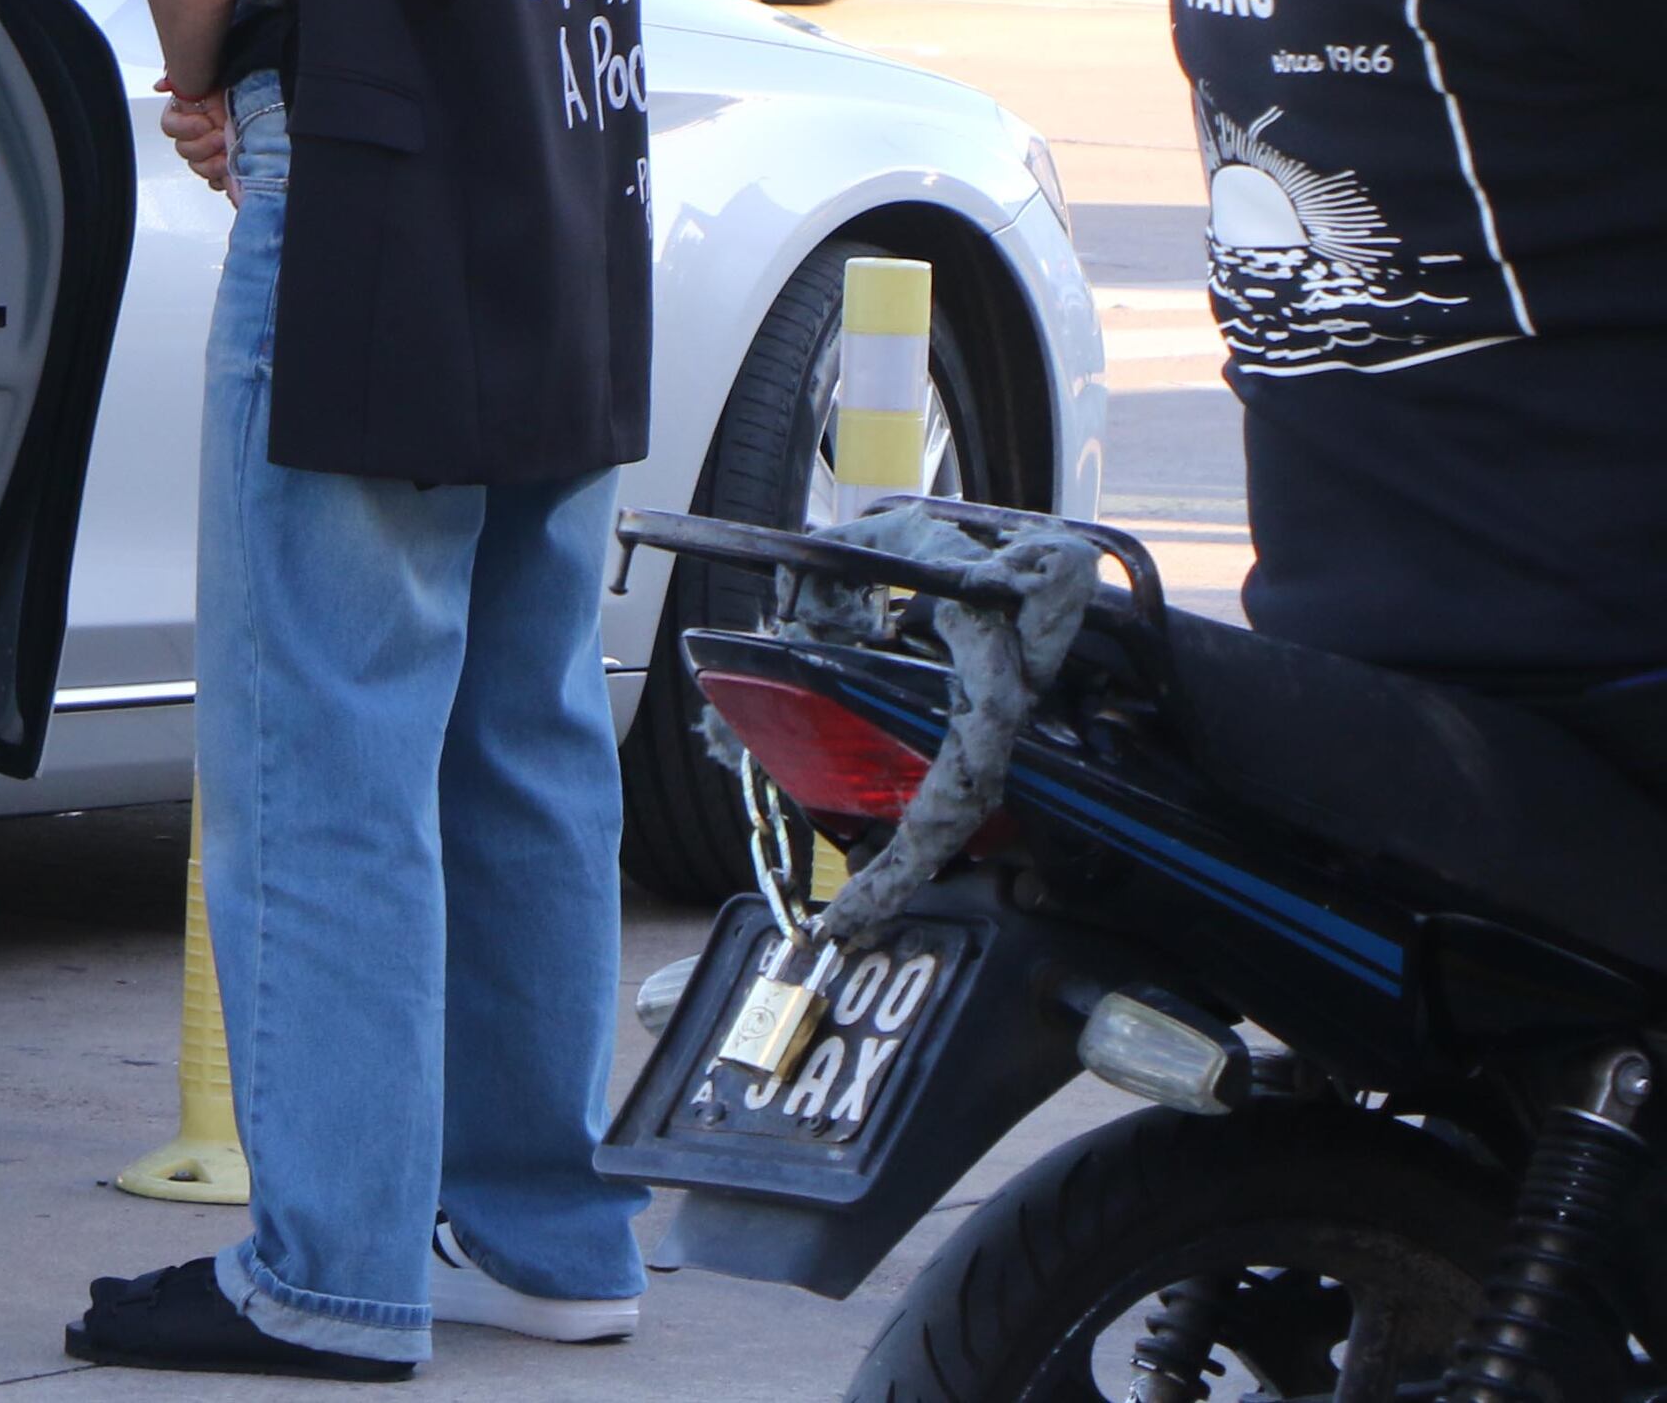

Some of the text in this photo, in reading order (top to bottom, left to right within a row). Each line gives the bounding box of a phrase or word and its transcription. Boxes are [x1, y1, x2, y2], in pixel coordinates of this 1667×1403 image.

[559, 25, 588, 130] A
[1270, 44, 1395, 74] since 1966
[817, 950, 936, 1034] 00
